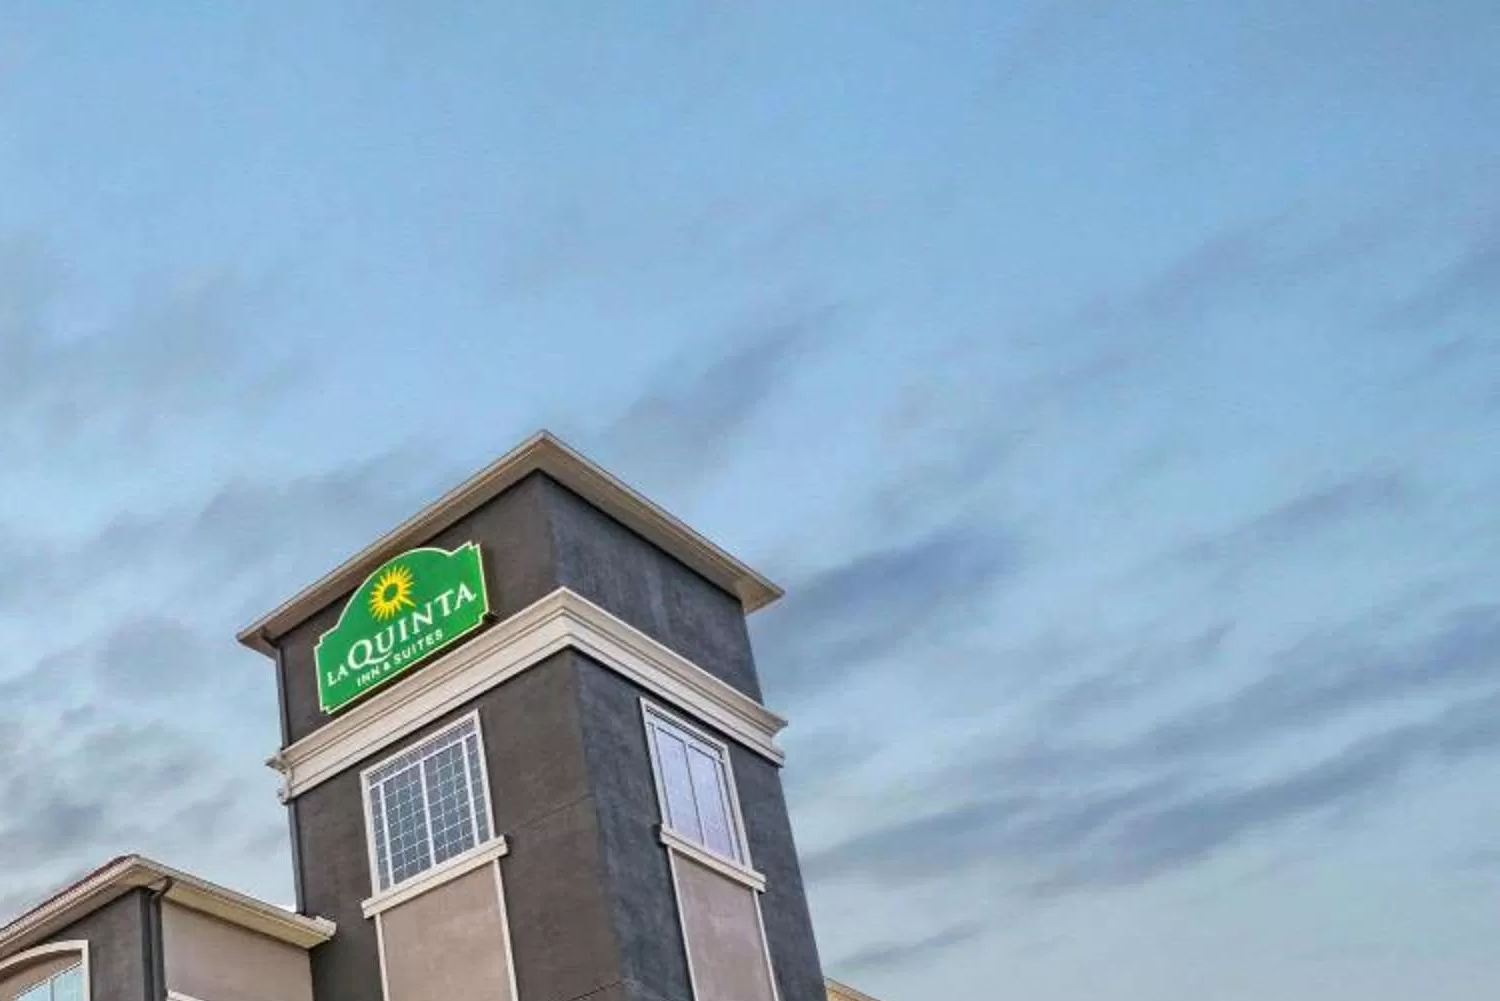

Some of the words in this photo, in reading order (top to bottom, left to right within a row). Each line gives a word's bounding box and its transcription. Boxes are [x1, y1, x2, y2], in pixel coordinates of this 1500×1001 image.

[327, 664, 349, 687] LA
[347, 583, 477, 671] QUINTA
[357, 665, 380, 687] INN
[393, 628, 443, 665] SUITES
